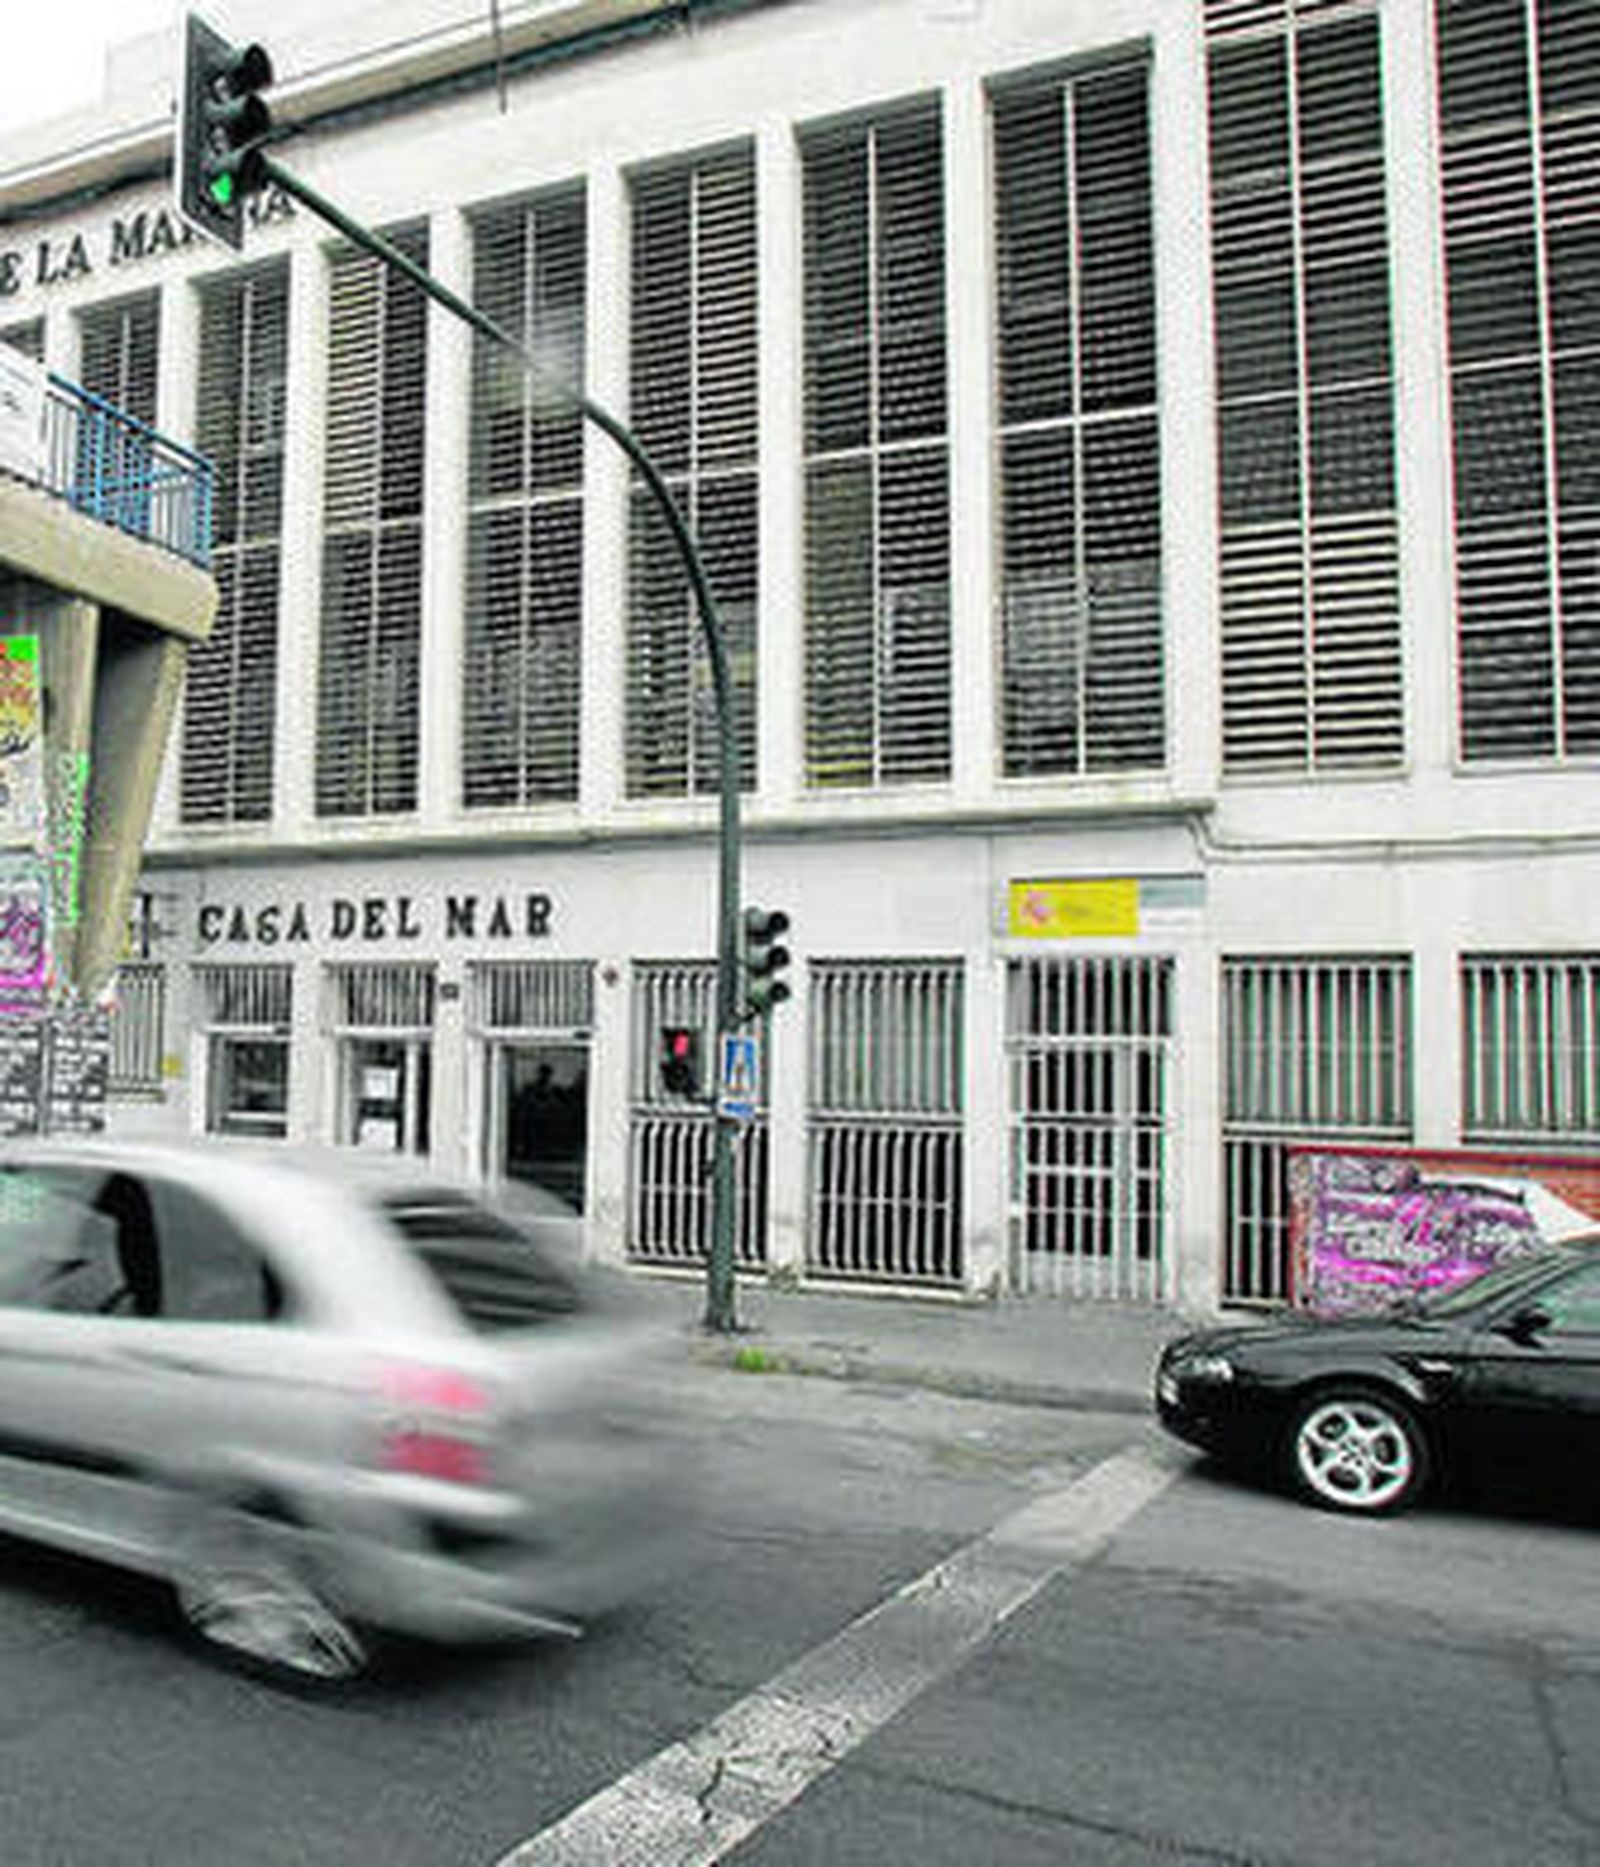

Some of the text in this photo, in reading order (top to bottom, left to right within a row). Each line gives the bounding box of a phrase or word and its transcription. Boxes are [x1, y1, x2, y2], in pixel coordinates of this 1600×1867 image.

[37, 233, 93, 285] LA
[198, 893, 552, 945] CASA DEL MAR
